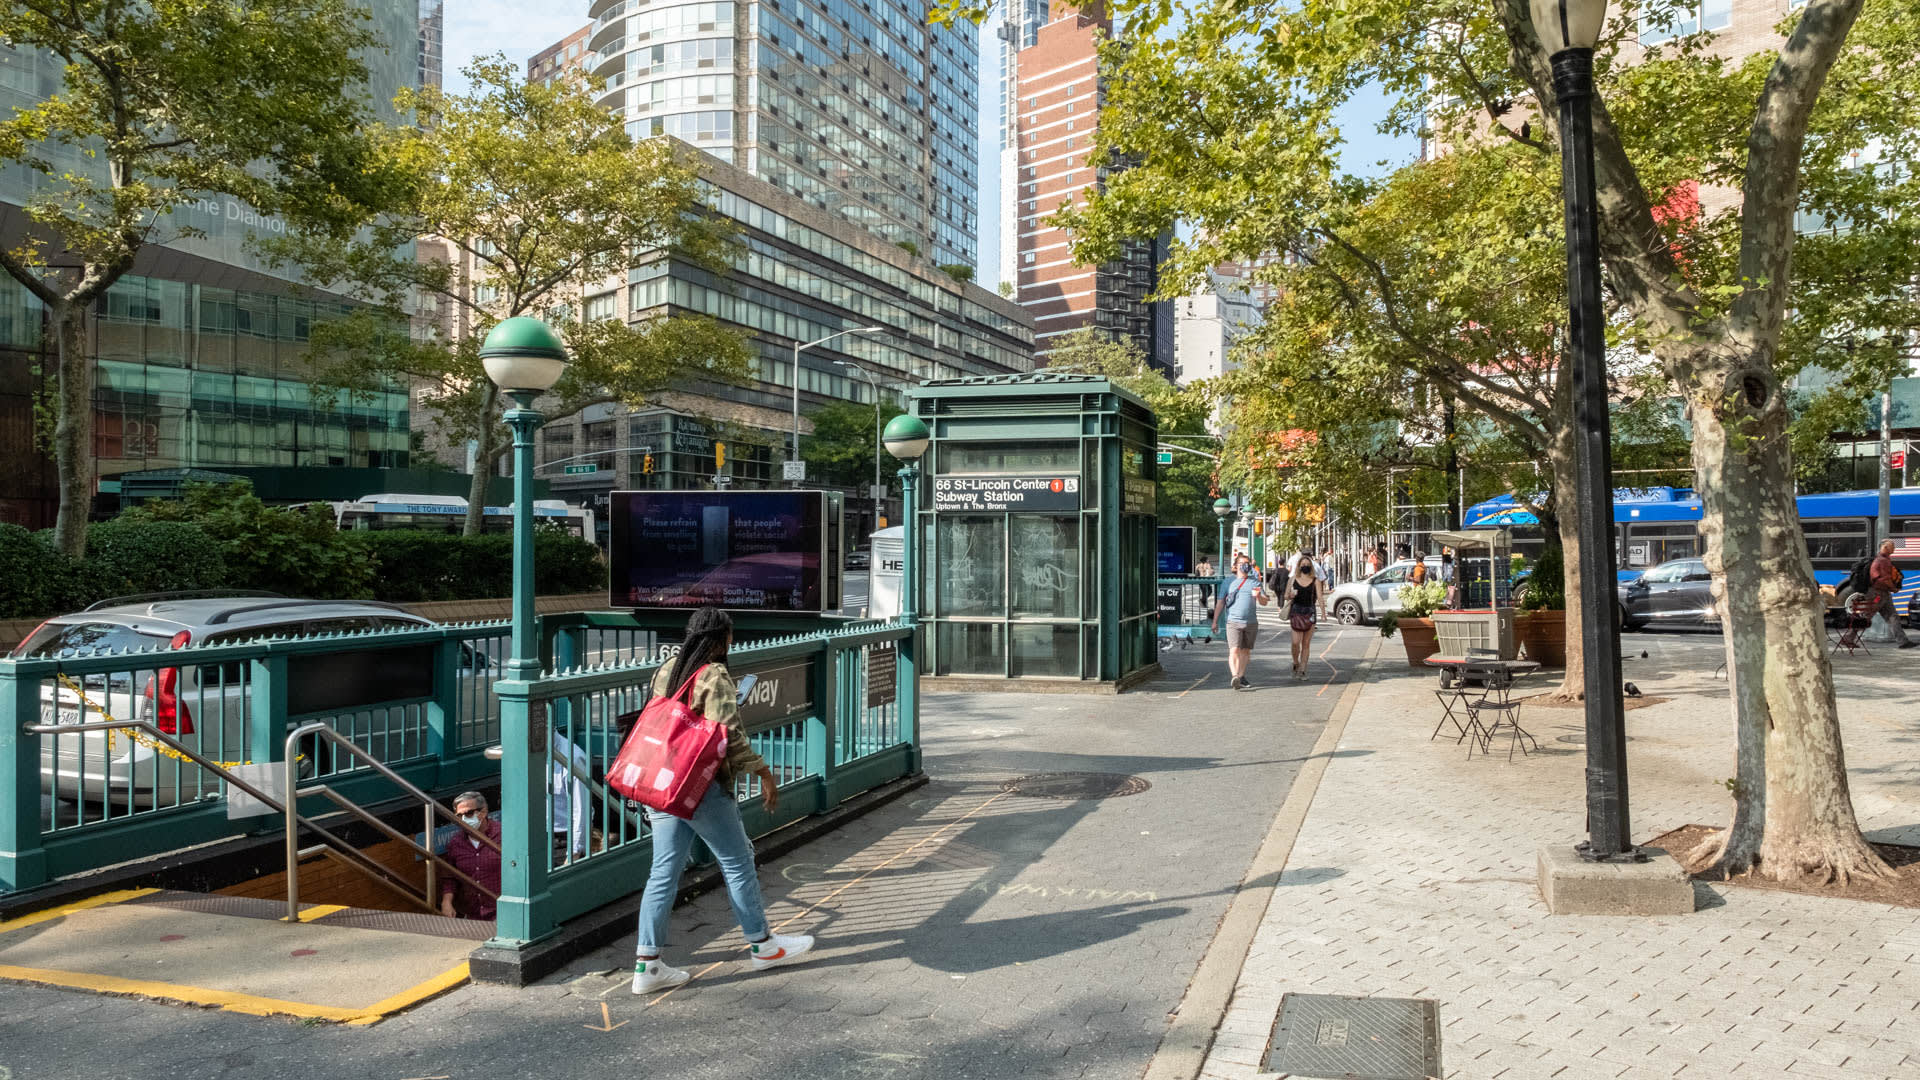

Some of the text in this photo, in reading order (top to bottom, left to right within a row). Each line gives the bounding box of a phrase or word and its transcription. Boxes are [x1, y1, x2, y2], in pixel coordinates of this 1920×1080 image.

[935, 479, 951, 491] 66
[954, 478, 1011, 491] St-Lincoln
[1013, 479, 1050, 490] Center
[935, 491, 1024, 504] Subway Station
[407, 505, 421, 513] THE
[423, 505, 441, 514] TONY
[935, 503, 961, 511] Uptown
[643, 516, 697, 527] Please refrain
[735, 517, 782, 530] that people
[723, 588, 765, 598] South Ferry
[1166, 588, 1179, 597] Ctr
[723, 597, 744, 606] South
[745, 597, 765, 607] Ferry
[747, 678, 779, 707] way
